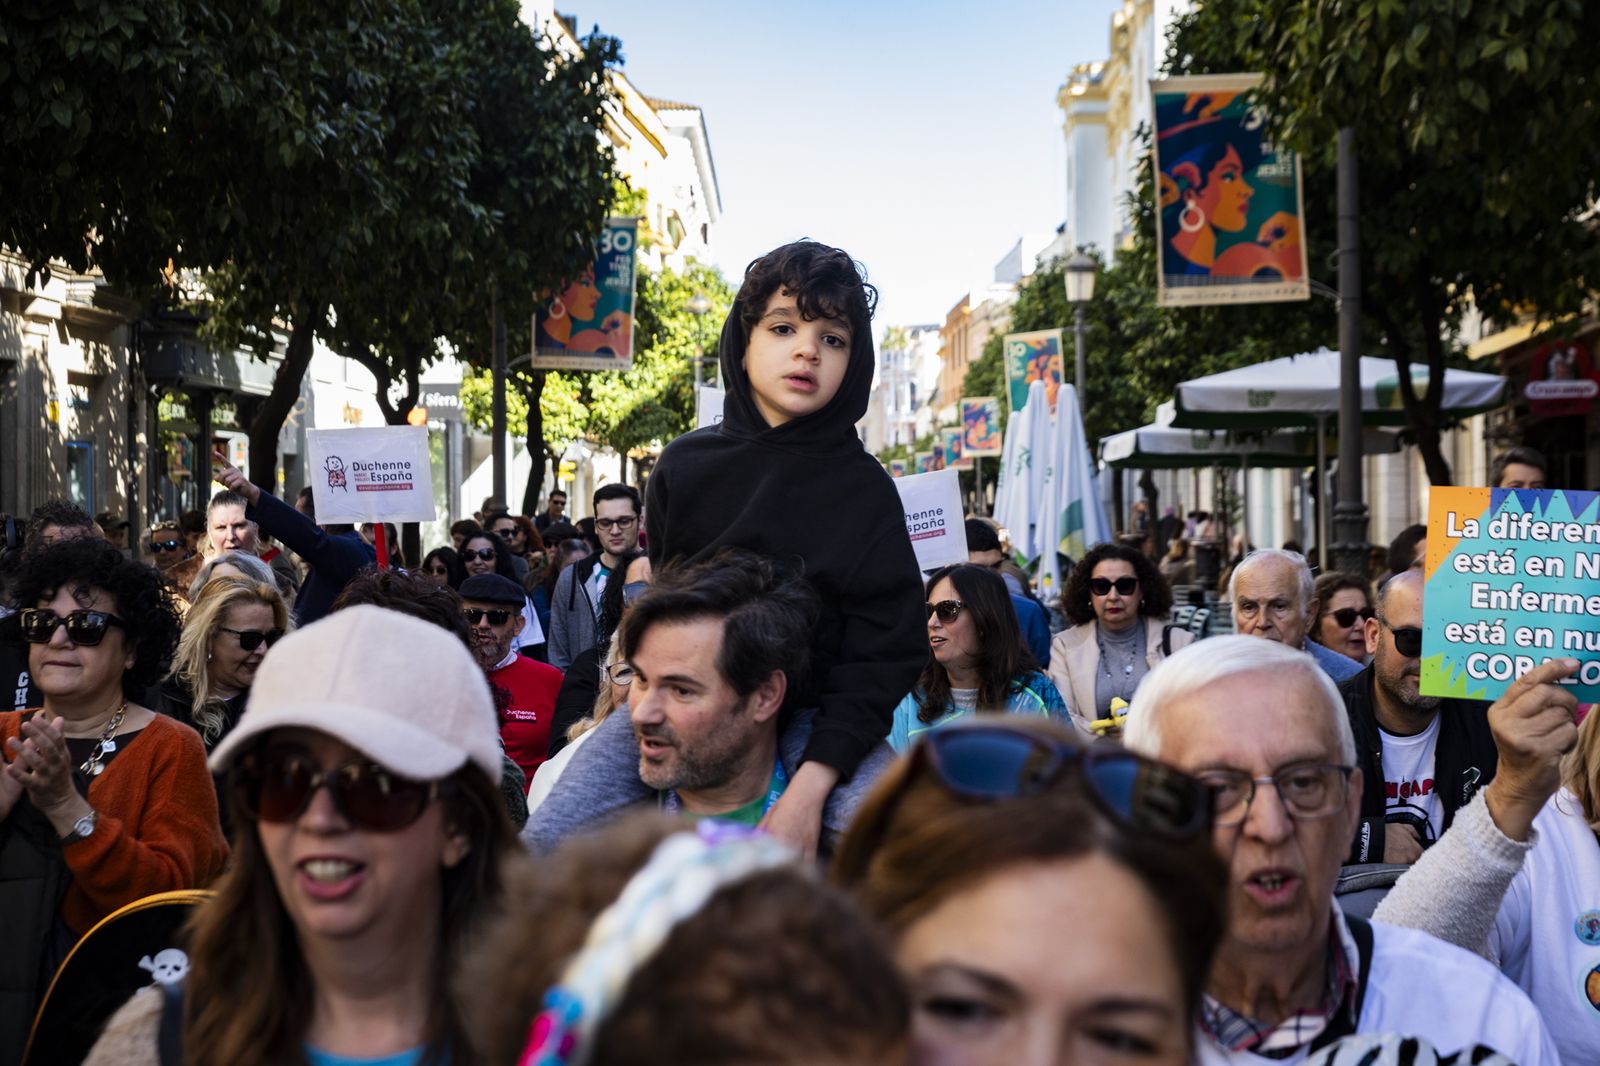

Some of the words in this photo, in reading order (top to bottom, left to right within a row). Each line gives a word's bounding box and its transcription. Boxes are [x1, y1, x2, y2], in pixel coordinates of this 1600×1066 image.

[602, 229, 632, 253] 30
[352, 461, 411, 471] Duchenne
[370, 471, 413, 483] España
[1446, 511, 1480, 539] La
[1487, 511, 1600, 544] diferen
[1452, 548, 1518, 576] está
[1523, 555, 1565, 578] en
[1470, 581, 1600, 616] Enferme
[1444, 618, 1508, 646] está
[1513, 626, 1554, 649] en
